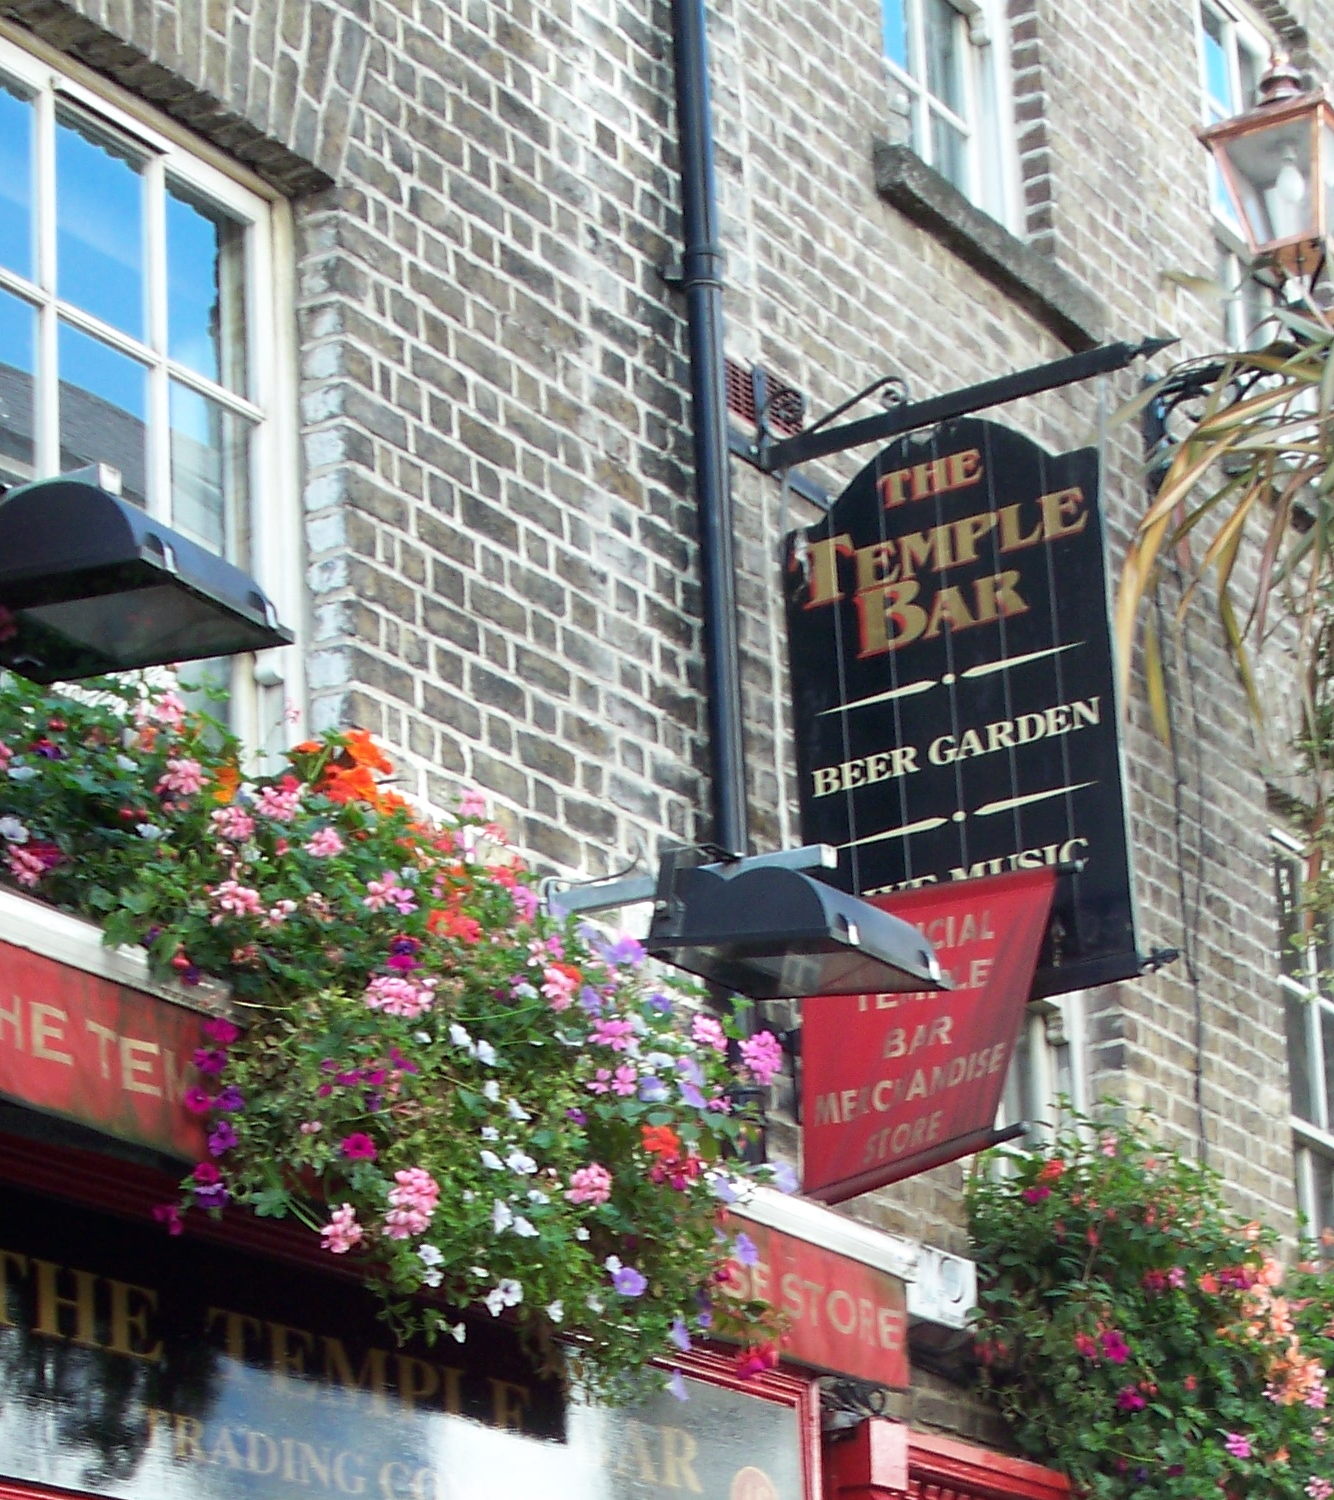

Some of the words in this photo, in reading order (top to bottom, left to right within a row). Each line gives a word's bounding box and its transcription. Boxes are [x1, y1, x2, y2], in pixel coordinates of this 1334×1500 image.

[876, 447, 985, 509] THE
[790, 486, 1090, 612] TEMPLE
[854, 568, 1029, 660] BAR
[812, 745, 921, 799] BEER
[927, 696, 1102, 766] GARDEN
[919, 910, 996, 951] CIAL
[882, 1015, 954, 1060] BAR
[863, 1110, 944, 1166] STORE
[781, 1271, 903, 1351] STORE
[143, 1406, 367, 1495] TRADING
[610, 1418, 703, 1495] AR
